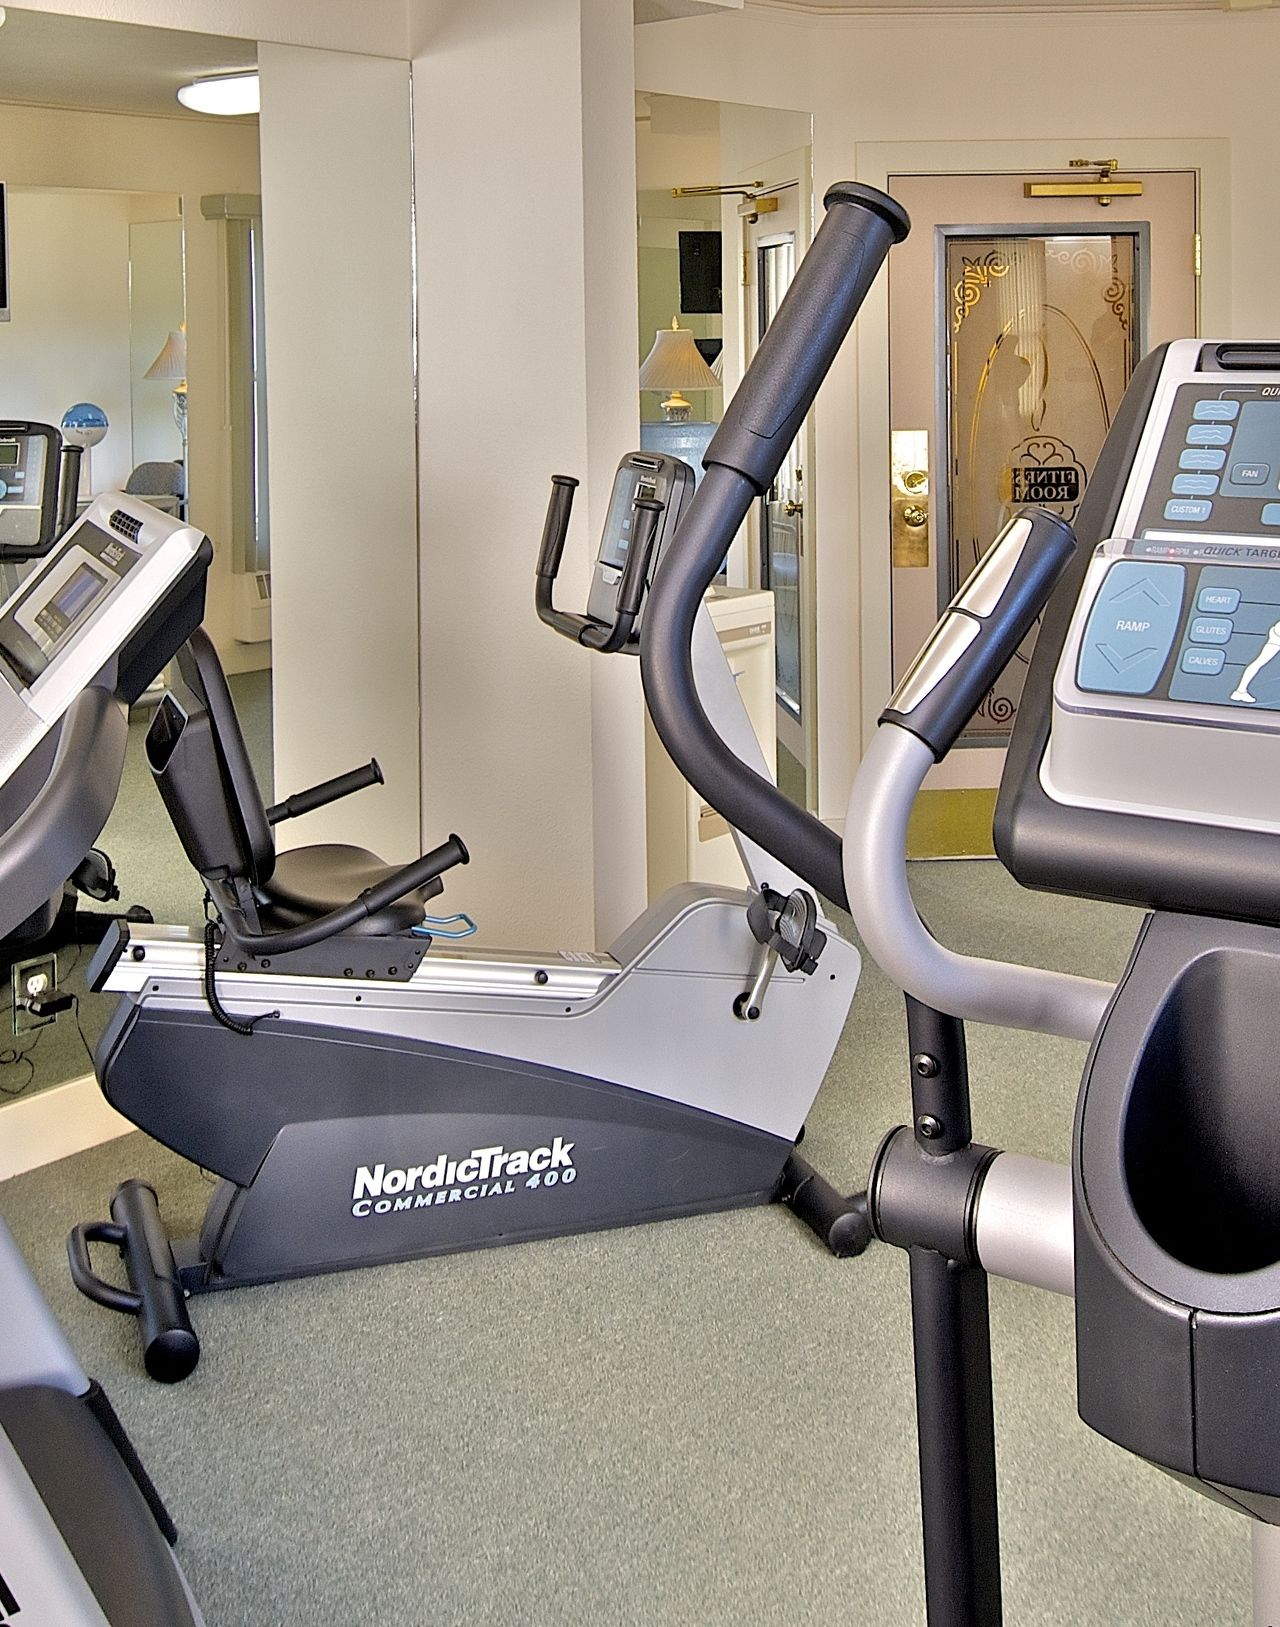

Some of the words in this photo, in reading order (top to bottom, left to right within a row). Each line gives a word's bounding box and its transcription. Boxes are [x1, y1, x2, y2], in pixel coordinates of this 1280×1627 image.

[1241, 469, 1259, 479] FAN
[1170, 504, 1201, 514] CUSTOM
[1203, 545, 1242, 557] QUICK
[1205, 595, 1232, 605] HEART
[1116, 619, 1150, 633] RAMP
[1195, 625, 1227, 636] GLUTES
[1188, 655, 1219, 666] CALVES
[352, 1136, 575, 1200] NordicTrack
[351, 1180, 516, 1218] COMMERCIAL
[525, 1167, 578, 1190] 400
